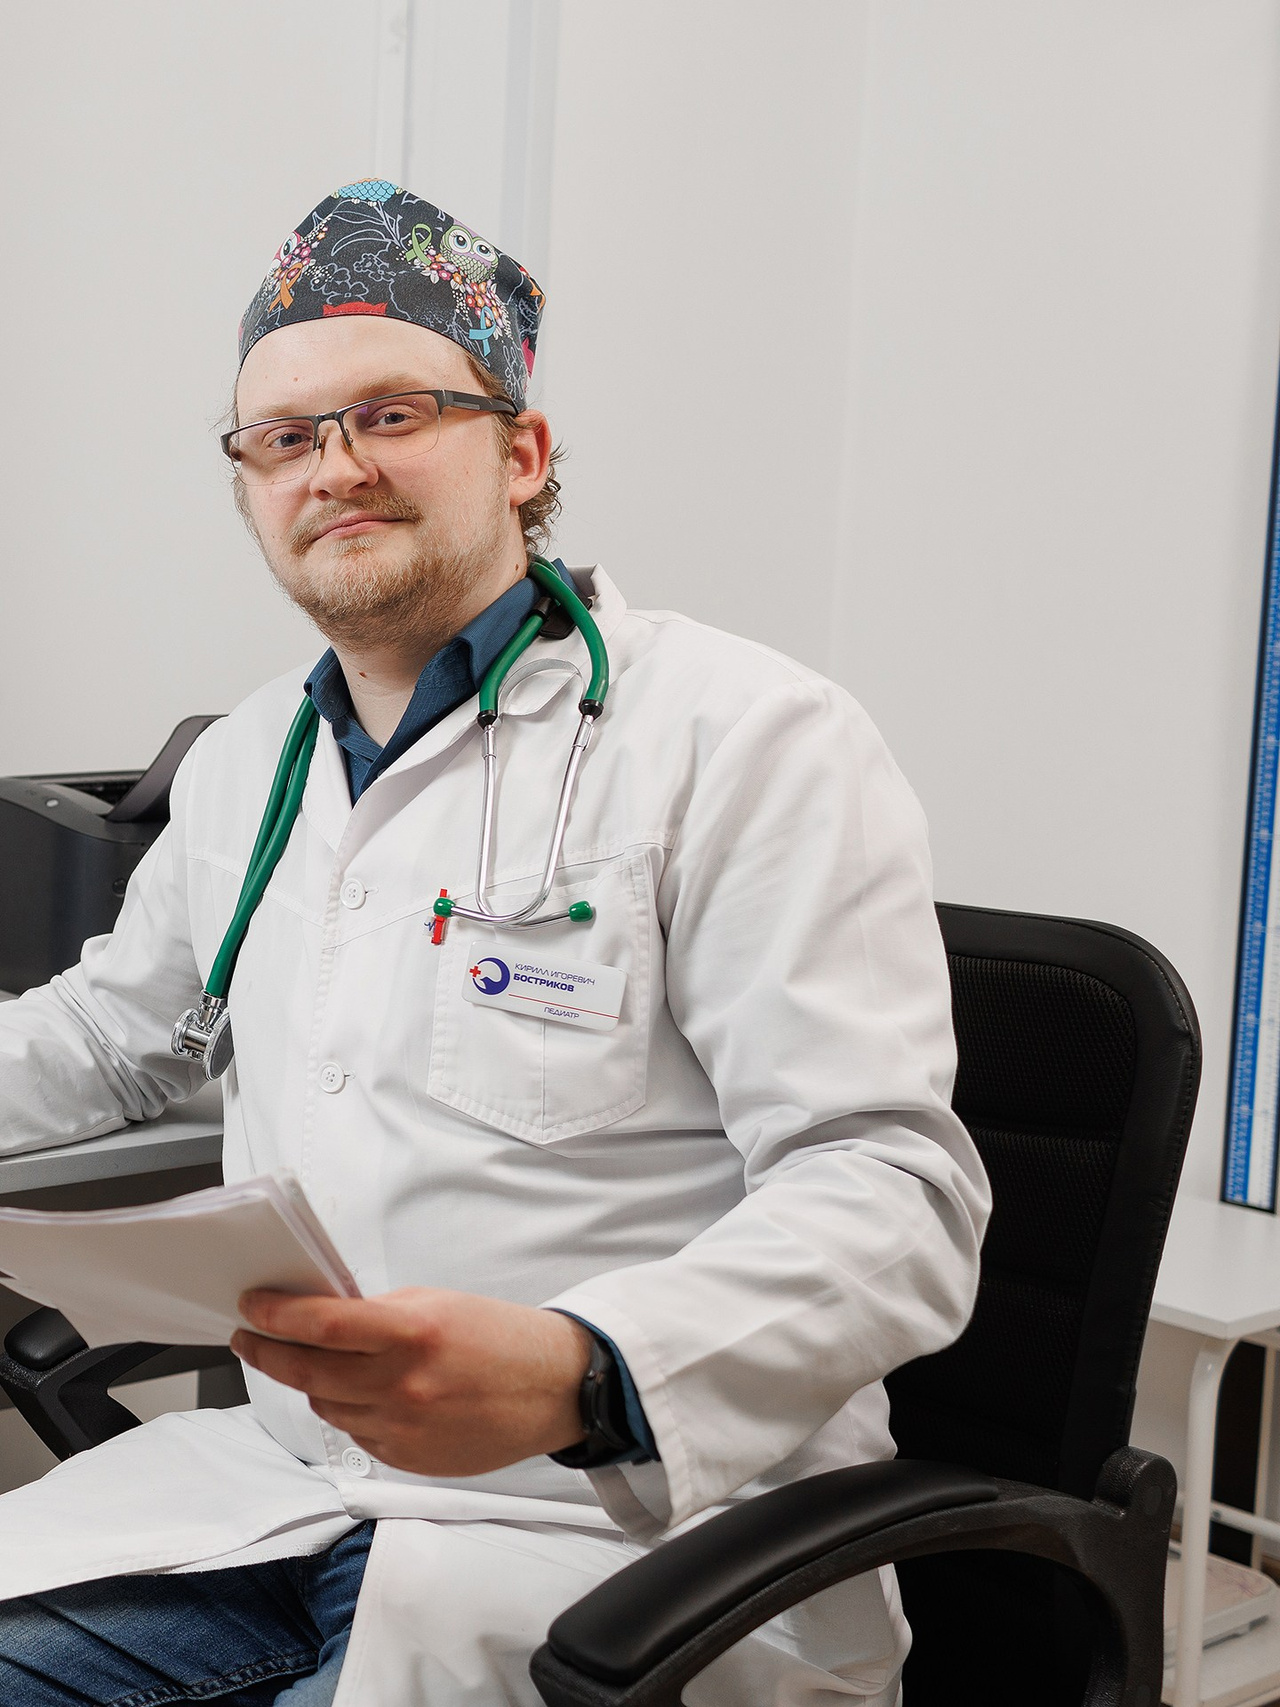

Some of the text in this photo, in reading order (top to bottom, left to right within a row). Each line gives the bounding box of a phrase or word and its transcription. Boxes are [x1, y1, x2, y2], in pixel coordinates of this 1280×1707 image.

[513, 973, 575, 992] БОСТРИКОВ
[514, 963, 596, 986] КИРИЛЛ ИГОРЕВИЧ
[544, 1006, 580, 1018] ПЕДИАТР
